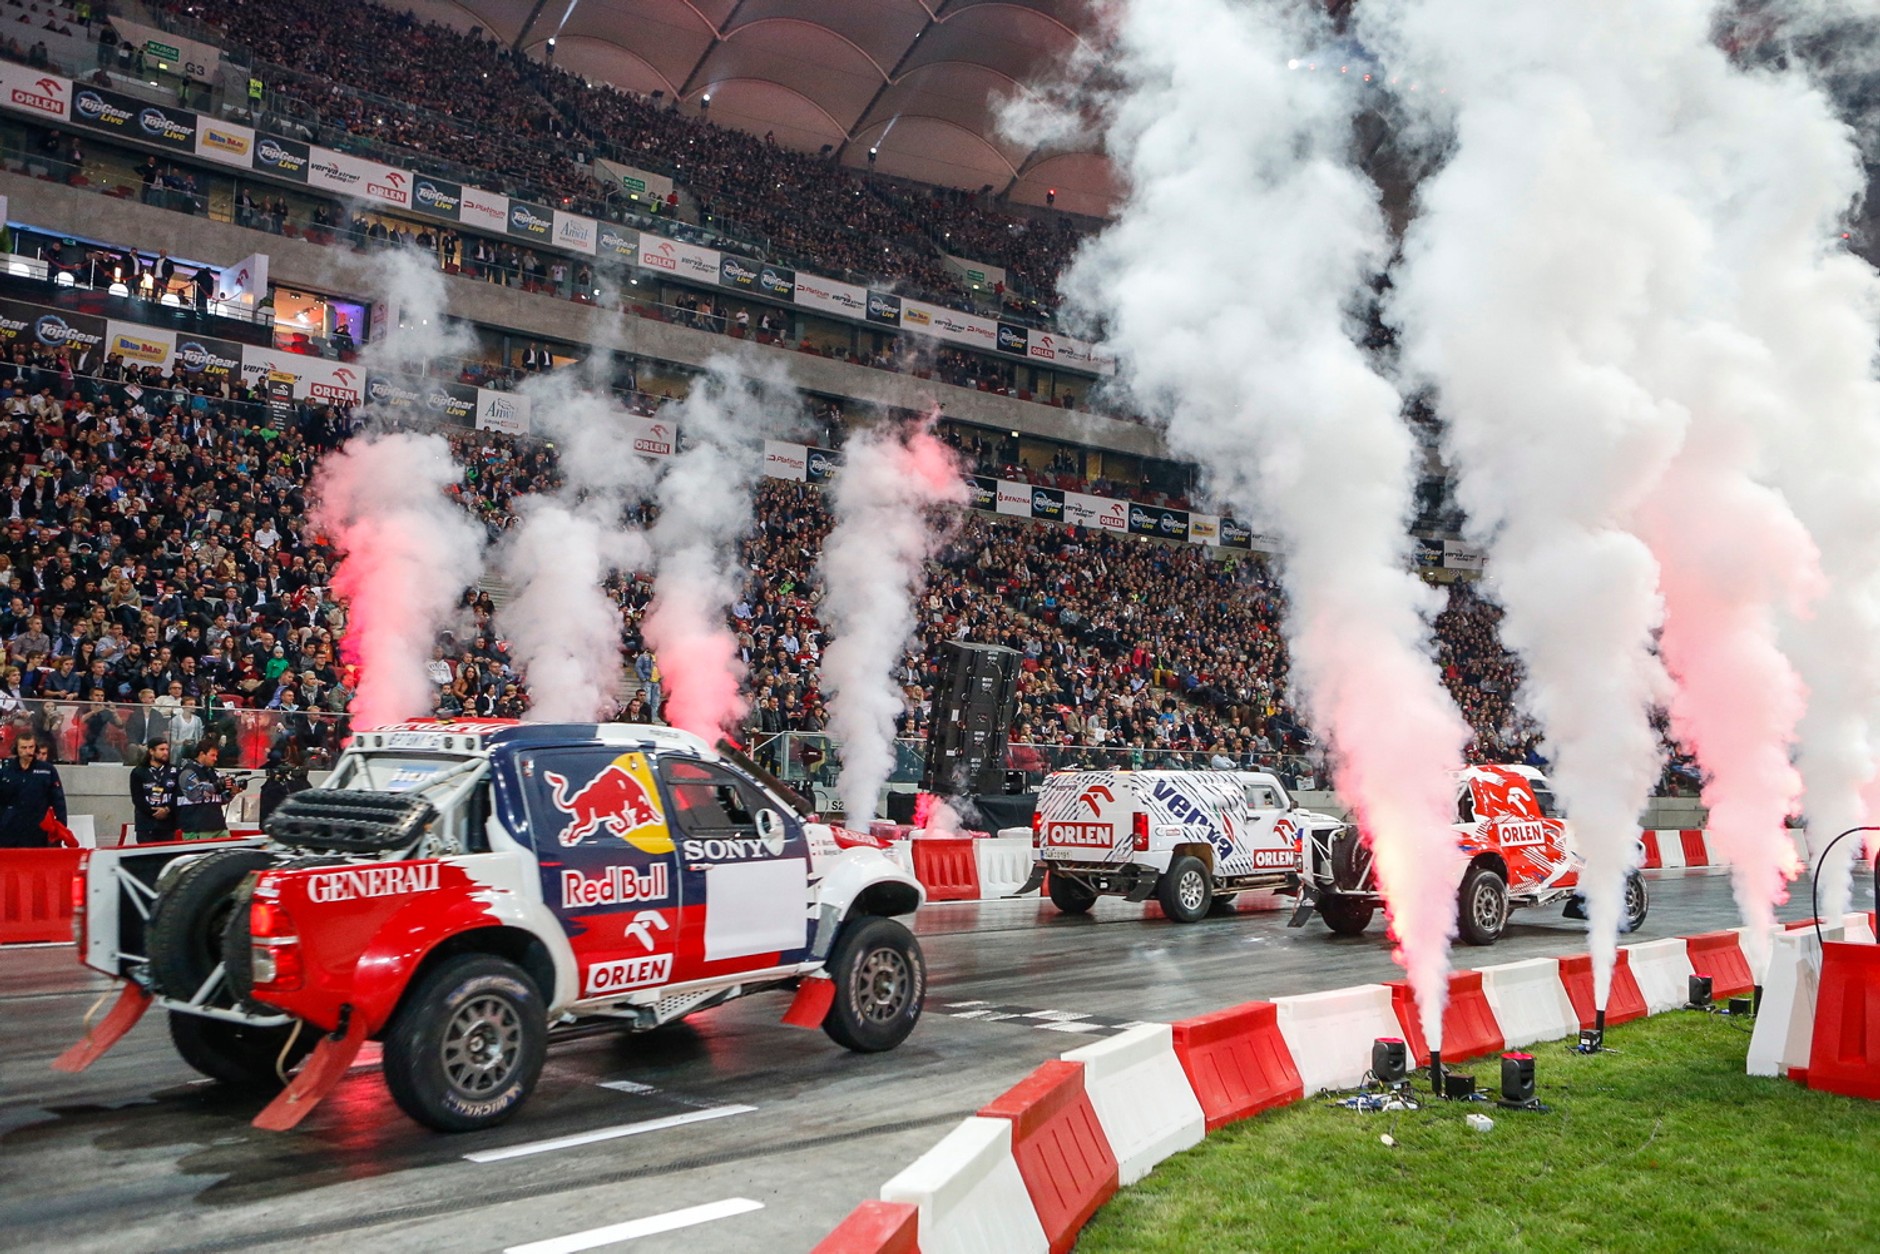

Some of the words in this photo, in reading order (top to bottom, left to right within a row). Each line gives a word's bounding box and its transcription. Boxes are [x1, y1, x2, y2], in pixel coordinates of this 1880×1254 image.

[185, 62, 205, 76] G3
[15, 92, 61, 113] ORLEN
[100, 113, 124, 126] Live
[163, 130, 186, 141] Live
[278, 160, 298, 171] Live
[310, 162, 339, 175] verva
[369, 185, 405, 201] ORLEN
[434, 200, 453, 210] Live
[473, 204, 506, 217] Platinum
[528, 224, 546, 234] Live
[616, 246, 632, 256] Live
[645, 255, 675, 269] ORLEN
[736, 276, 753, 284] Live
[774, 285, 789, 294] Live
[805, 286, 829, 298] Platinum
[882, 311, 896, 319] Live
[1031, 347, 1053, 358] ORLEN
[243, 364, 271, 375] verv
[313, 384, 355, 401] ORLEN
[446, 406, 467, 417] Live
[635, 440, 669, 454] ORLEN
[776, 456, 805, 467] Platinum
[1004, 495, 1031, 505] BENZINA
[1045, 506, 1059, 514] Live
[1101, 517, 1124, 527] ORLEN
[1142, 522, 1154, 530] Live
[1172, 527, 1184, 535] Live
[1152, 778, 1234, 861] verva
[1051, 825, 1111, 845] ORLEN
[1502, 826, 1543, 844] ORLEN
[683, 838, 764, 861] SONY
[1255, 851, 1294, 867] ORLEN
[307, 863, 441, 904] GENERALI
[561, 866, 617, 909] Red
[618, 862, 669, 903] Bull
[594, 959, 666, 988] ORLEN
